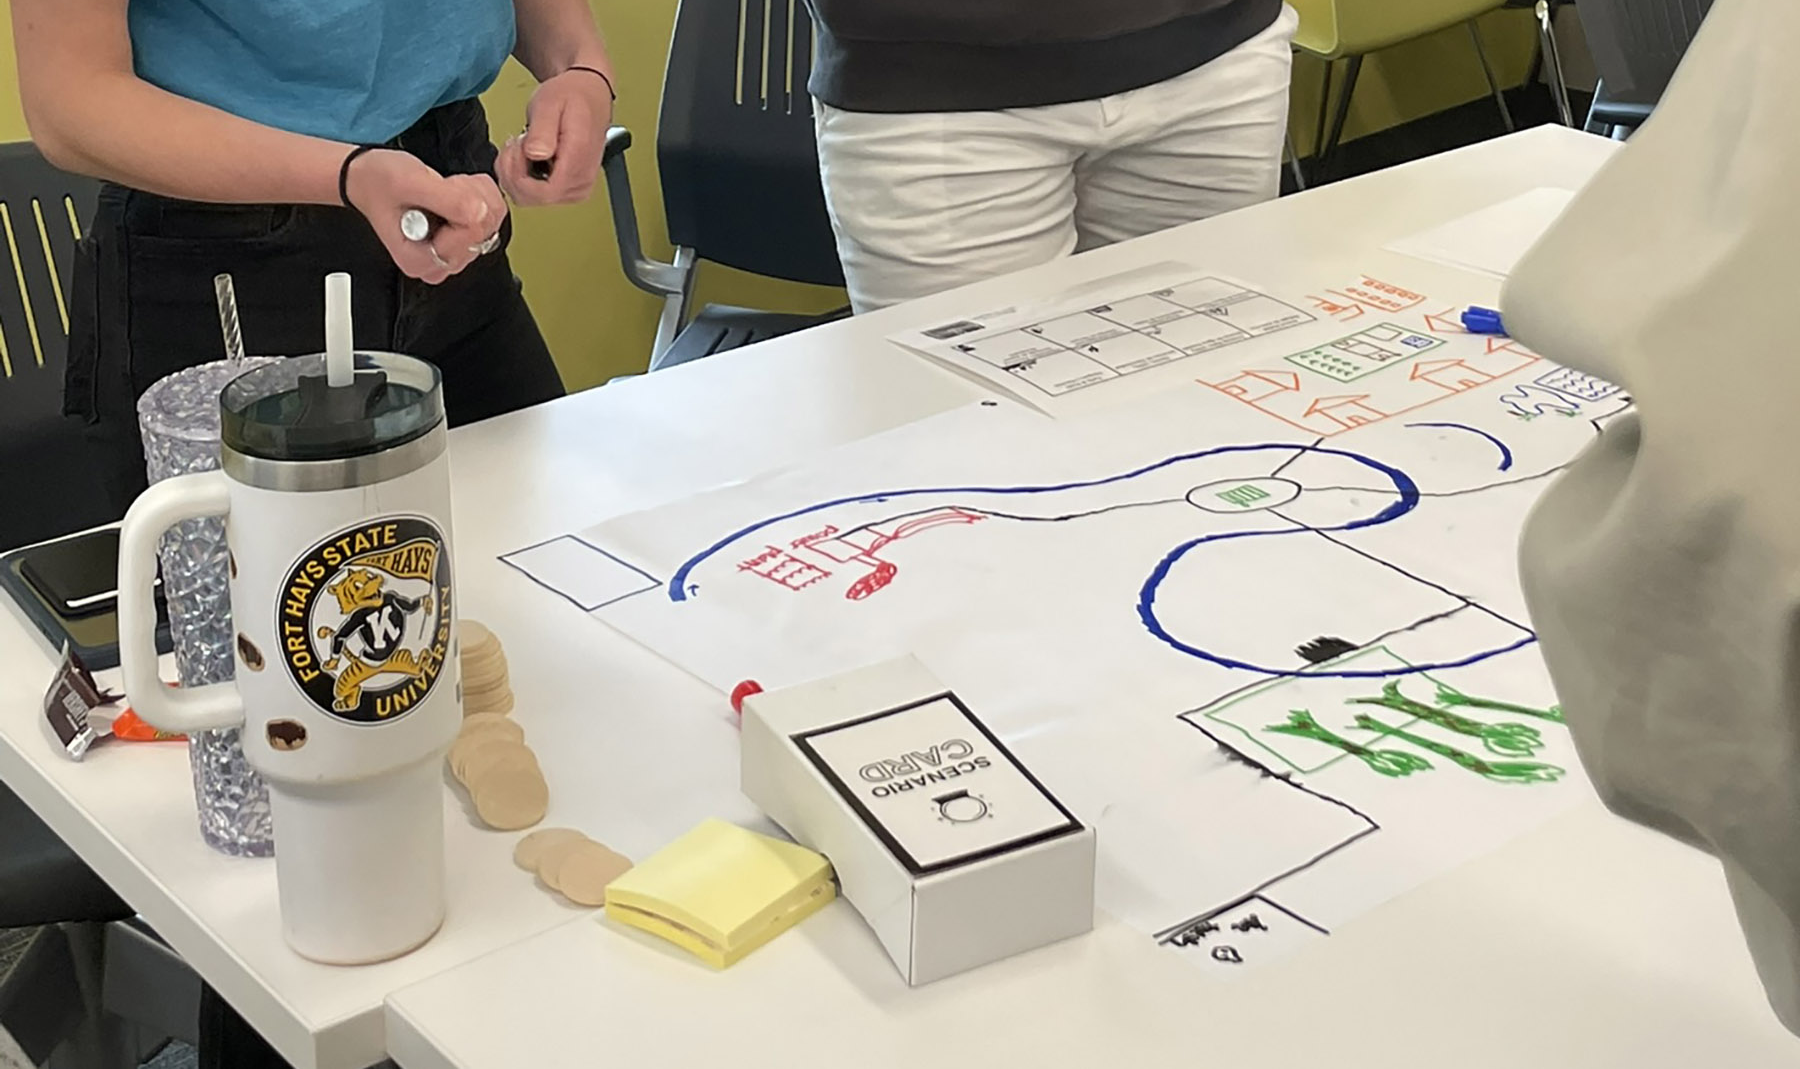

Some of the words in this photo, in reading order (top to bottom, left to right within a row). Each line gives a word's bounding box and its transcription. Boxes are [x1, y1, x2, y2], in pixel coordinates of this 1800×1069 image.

[322, 524, 398, 566] STATE
[390, 546, 432, 574] HAYS
[285, 559, 326, 617] HAYS
[285, 621, 320, 682] FORT
[376, 585, 450, 716] UNIVERSITY
[859, 739, 974, 783] CARD
[871, 756, 992, 799] SCENARIO
